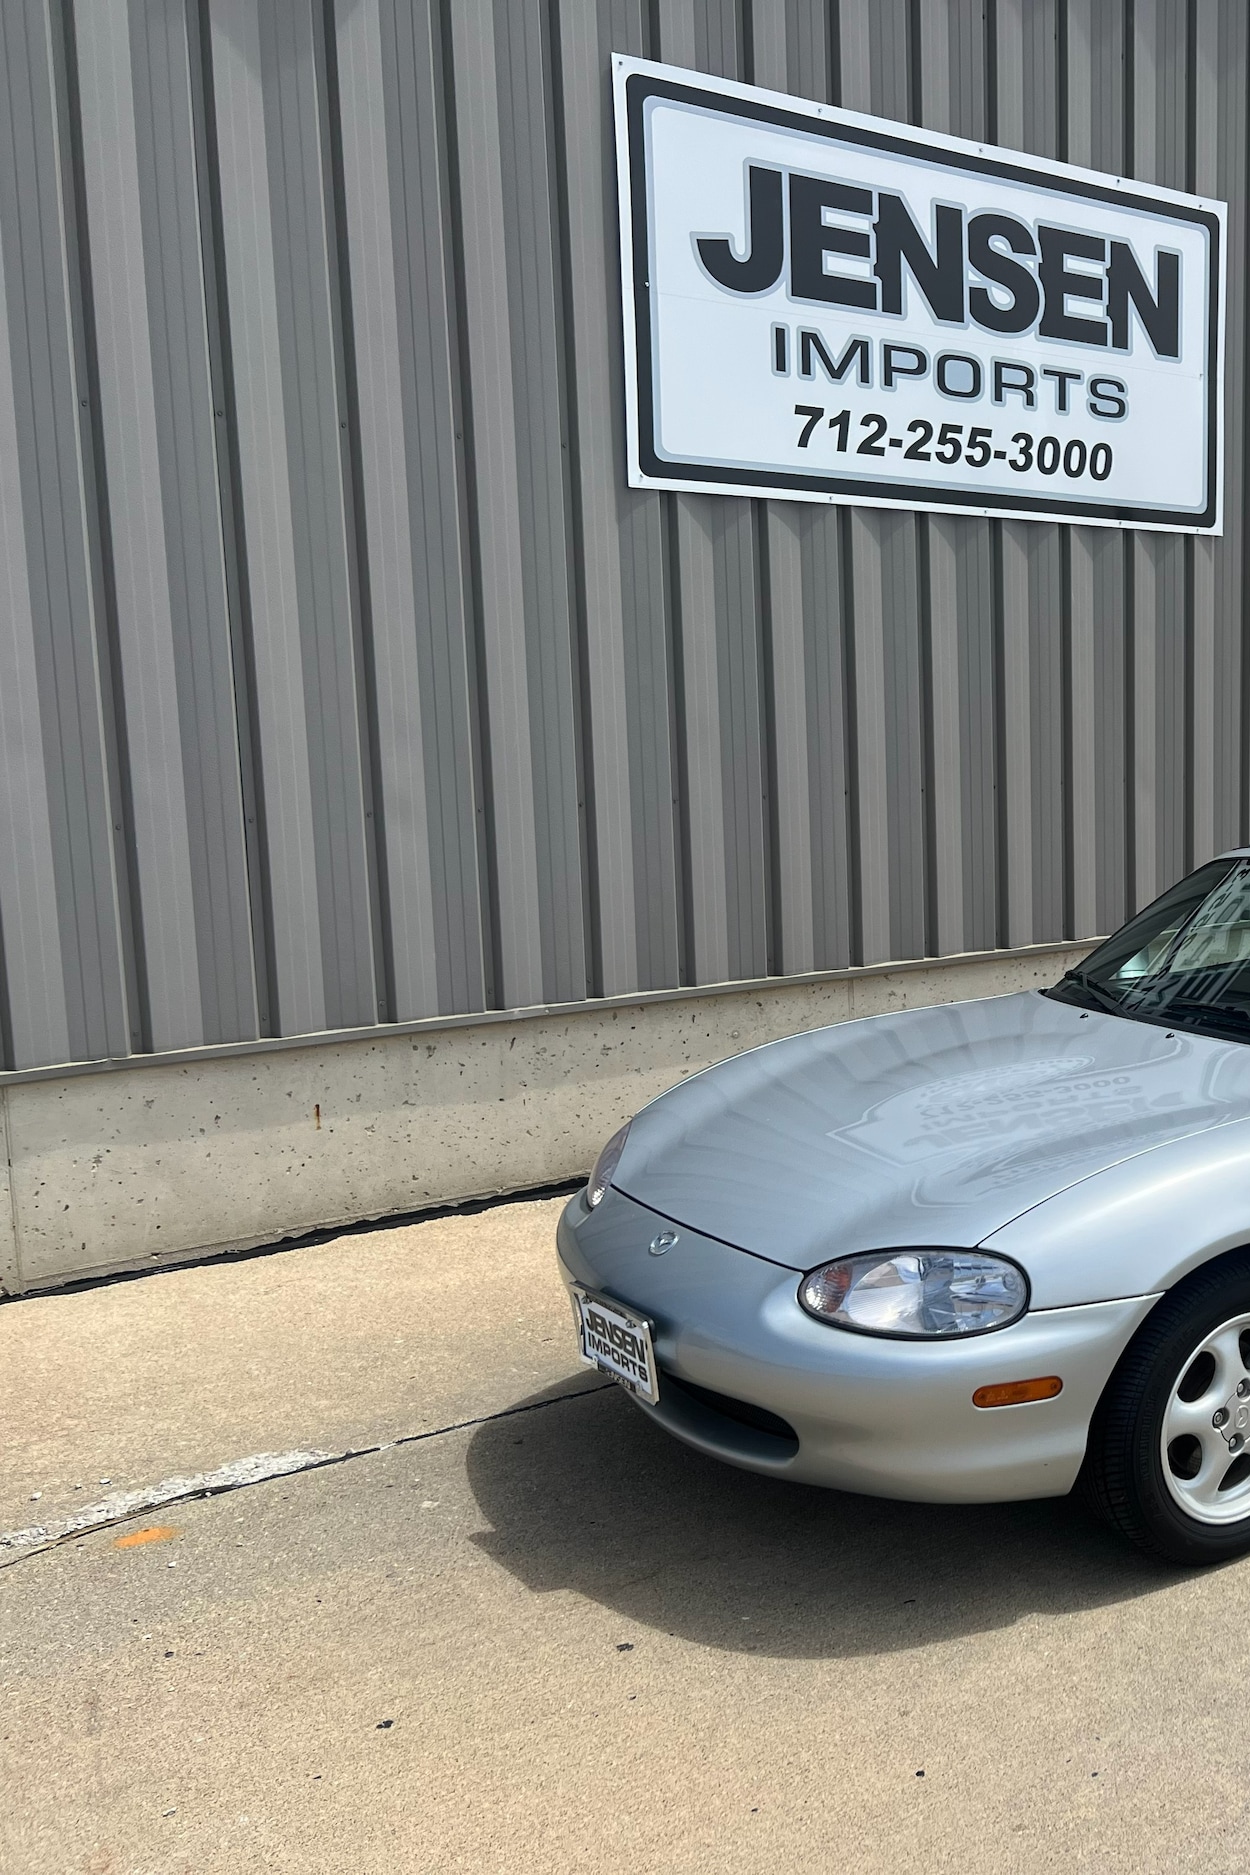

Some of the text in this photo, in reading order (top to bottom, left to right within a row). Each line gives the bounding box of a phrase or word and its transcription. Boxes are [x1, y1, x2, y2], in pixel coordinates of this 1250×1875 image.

[693, 161, 1183, 361] JENSEN
[773, 324, 1129, 421] IMPORTS
[793, 403, 1114, 482] 712-255-3000
[585, 1307, 647, 1366] JENSEN
[587, 1331, 649, 1384] IMPORTS
